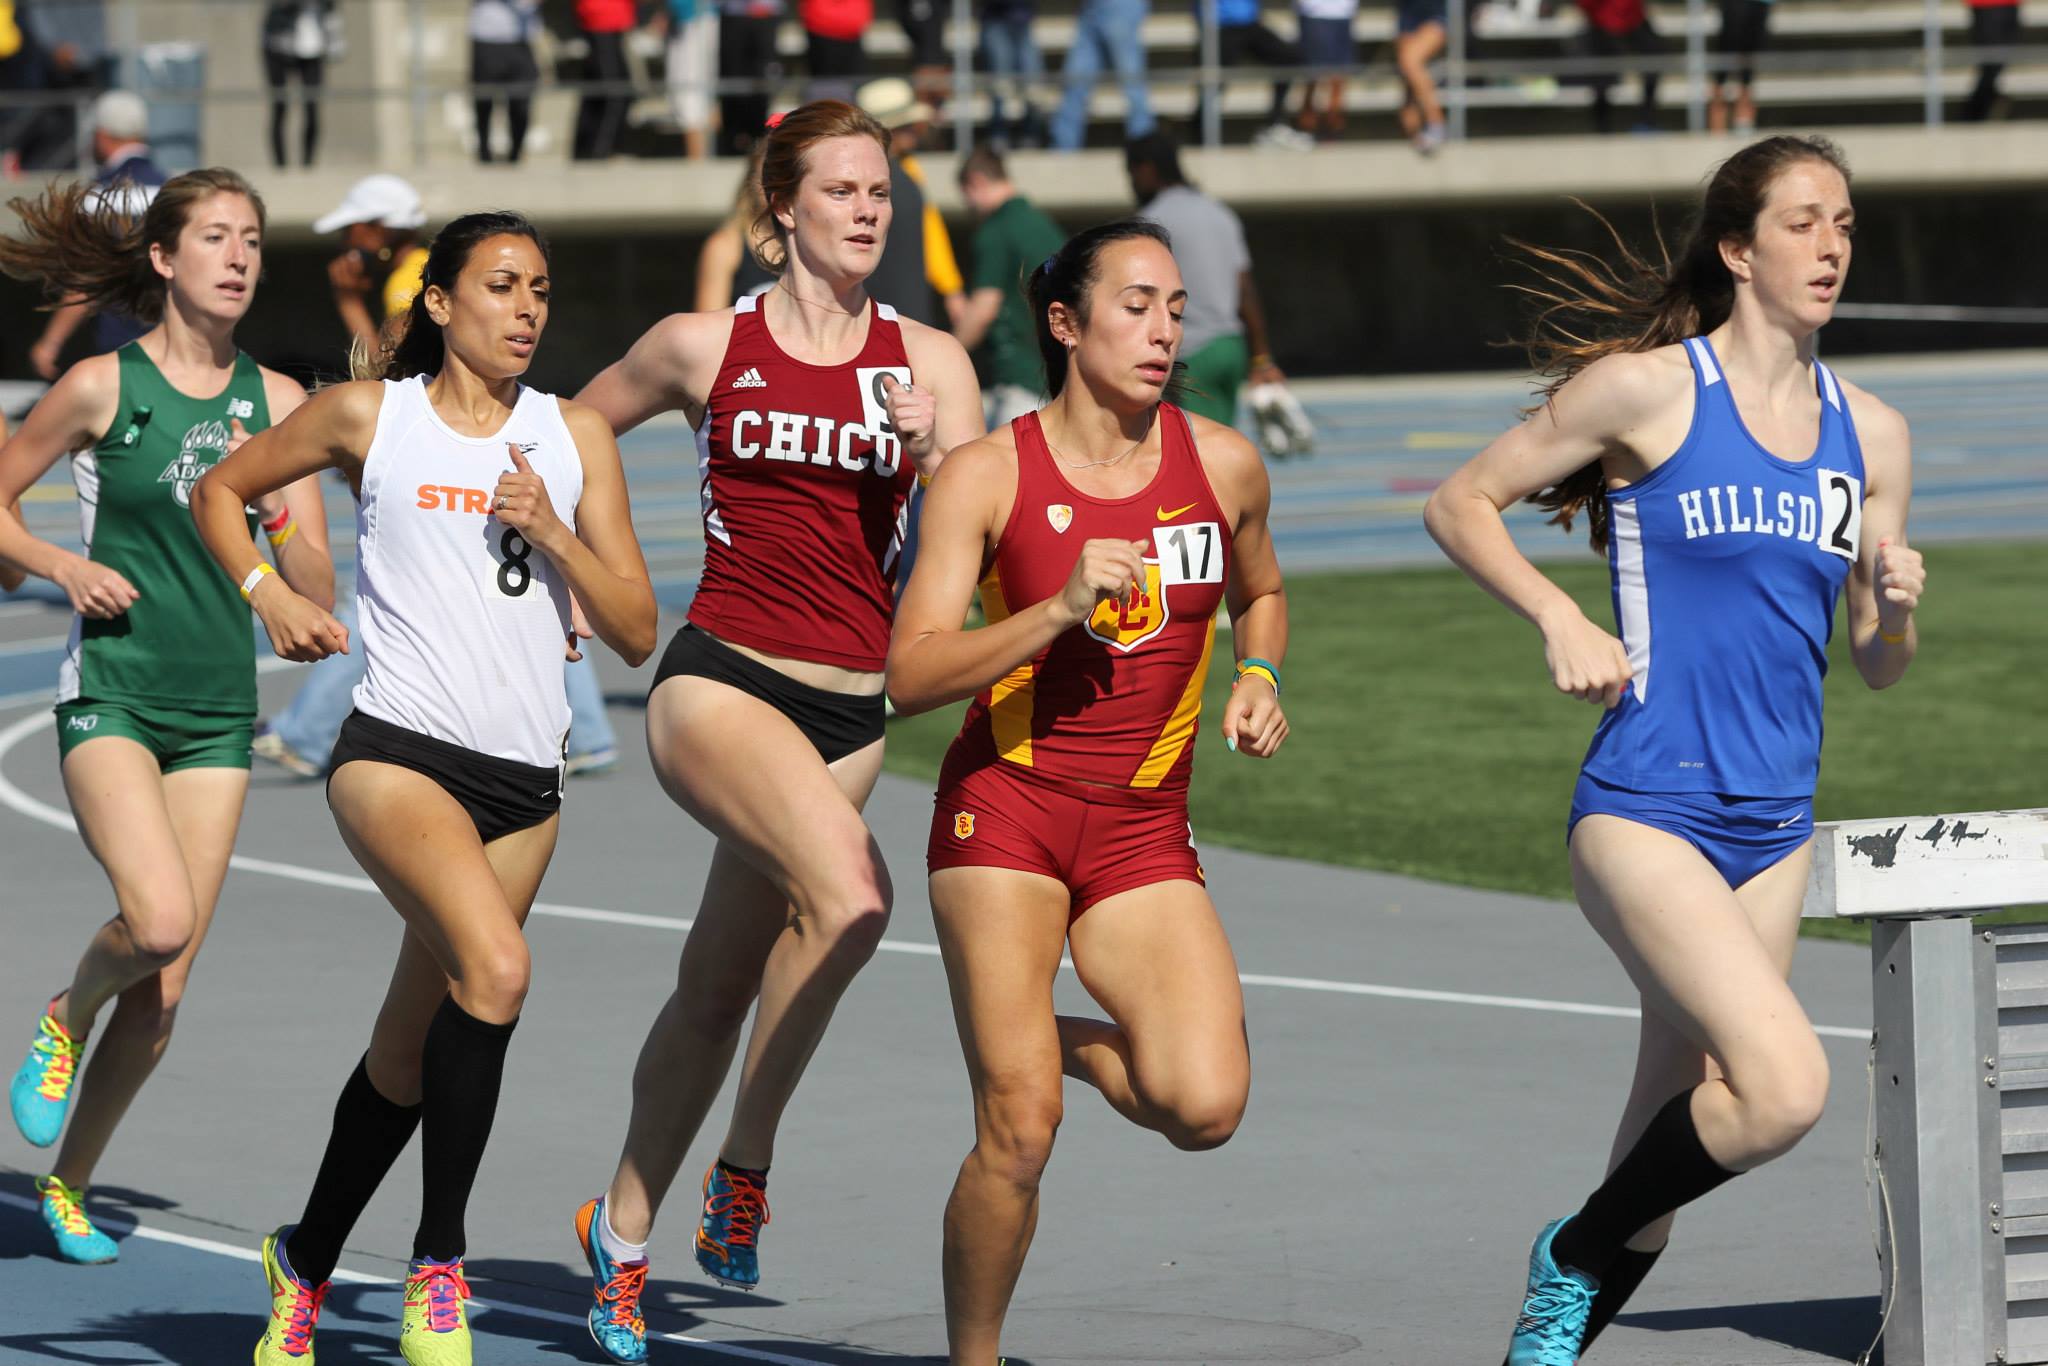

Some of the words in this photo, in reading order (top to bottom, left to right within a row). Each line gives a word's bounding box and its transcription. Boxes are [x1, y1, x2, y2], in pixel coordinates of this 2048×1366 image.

[732, 379, 767, 388] adidas
[732, 410, 902, 478] CHICO
[1678, 485, 1821, 542] HILLSD
[1830, 477, 1854, 553] 2
[497, 527, 533, 597] 8
[1168, 526, 1211, 580] 17
